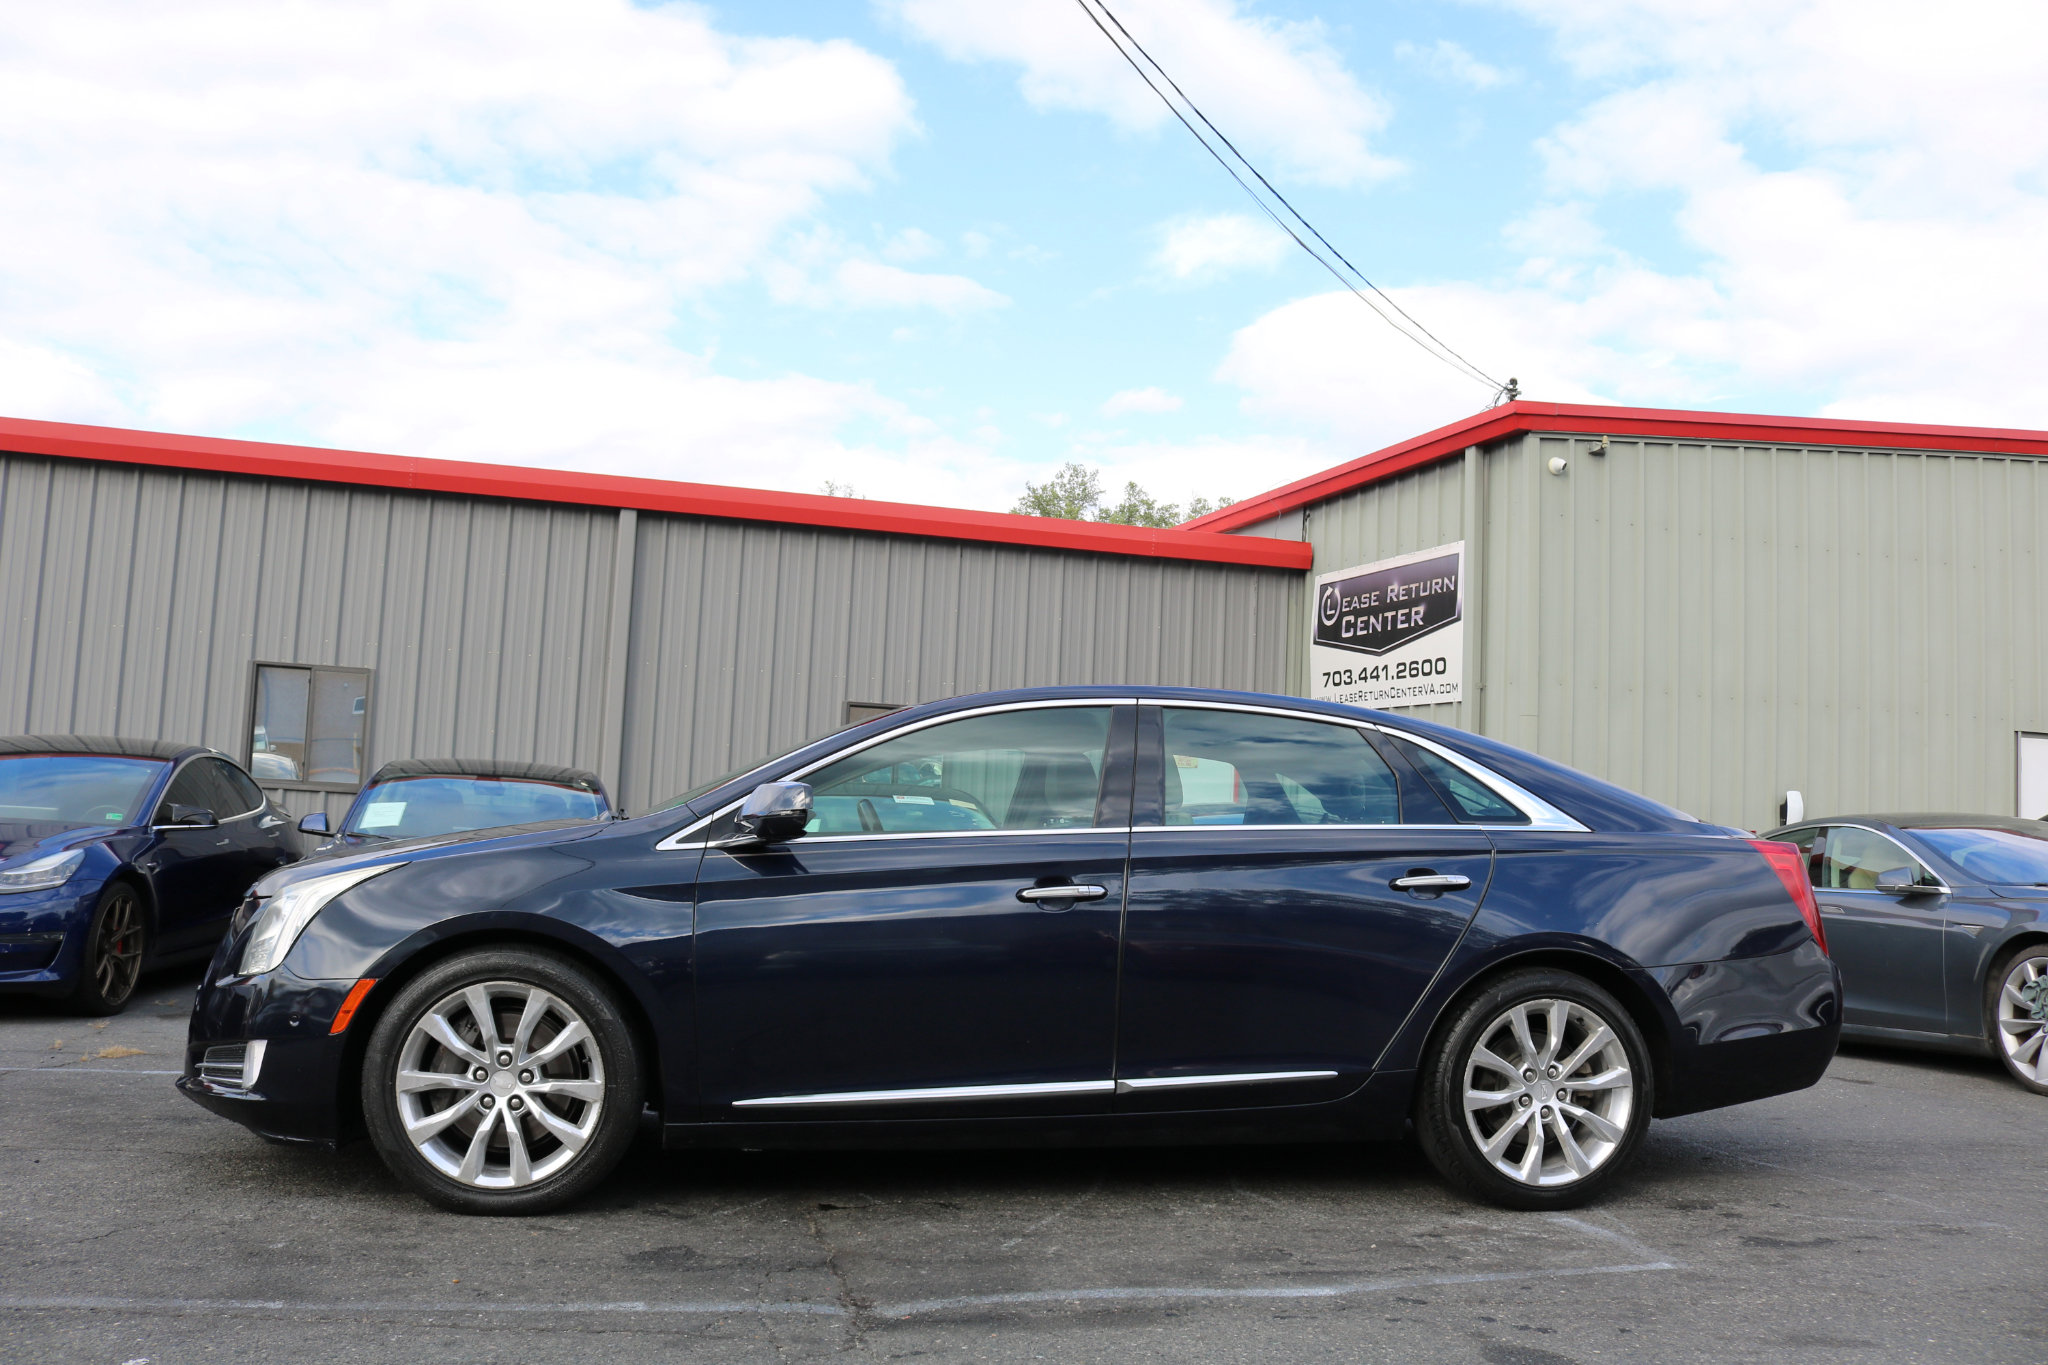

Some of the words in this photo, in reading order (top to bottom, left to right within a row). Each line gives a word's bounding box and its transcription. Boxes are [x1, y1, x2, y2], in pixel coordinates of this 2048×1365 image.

[1386, 576, 1456, 604] RETURN
[1341, 606, 1425, 638] CENTER
[1322, 657, 1447, 688] 703.441.2600
